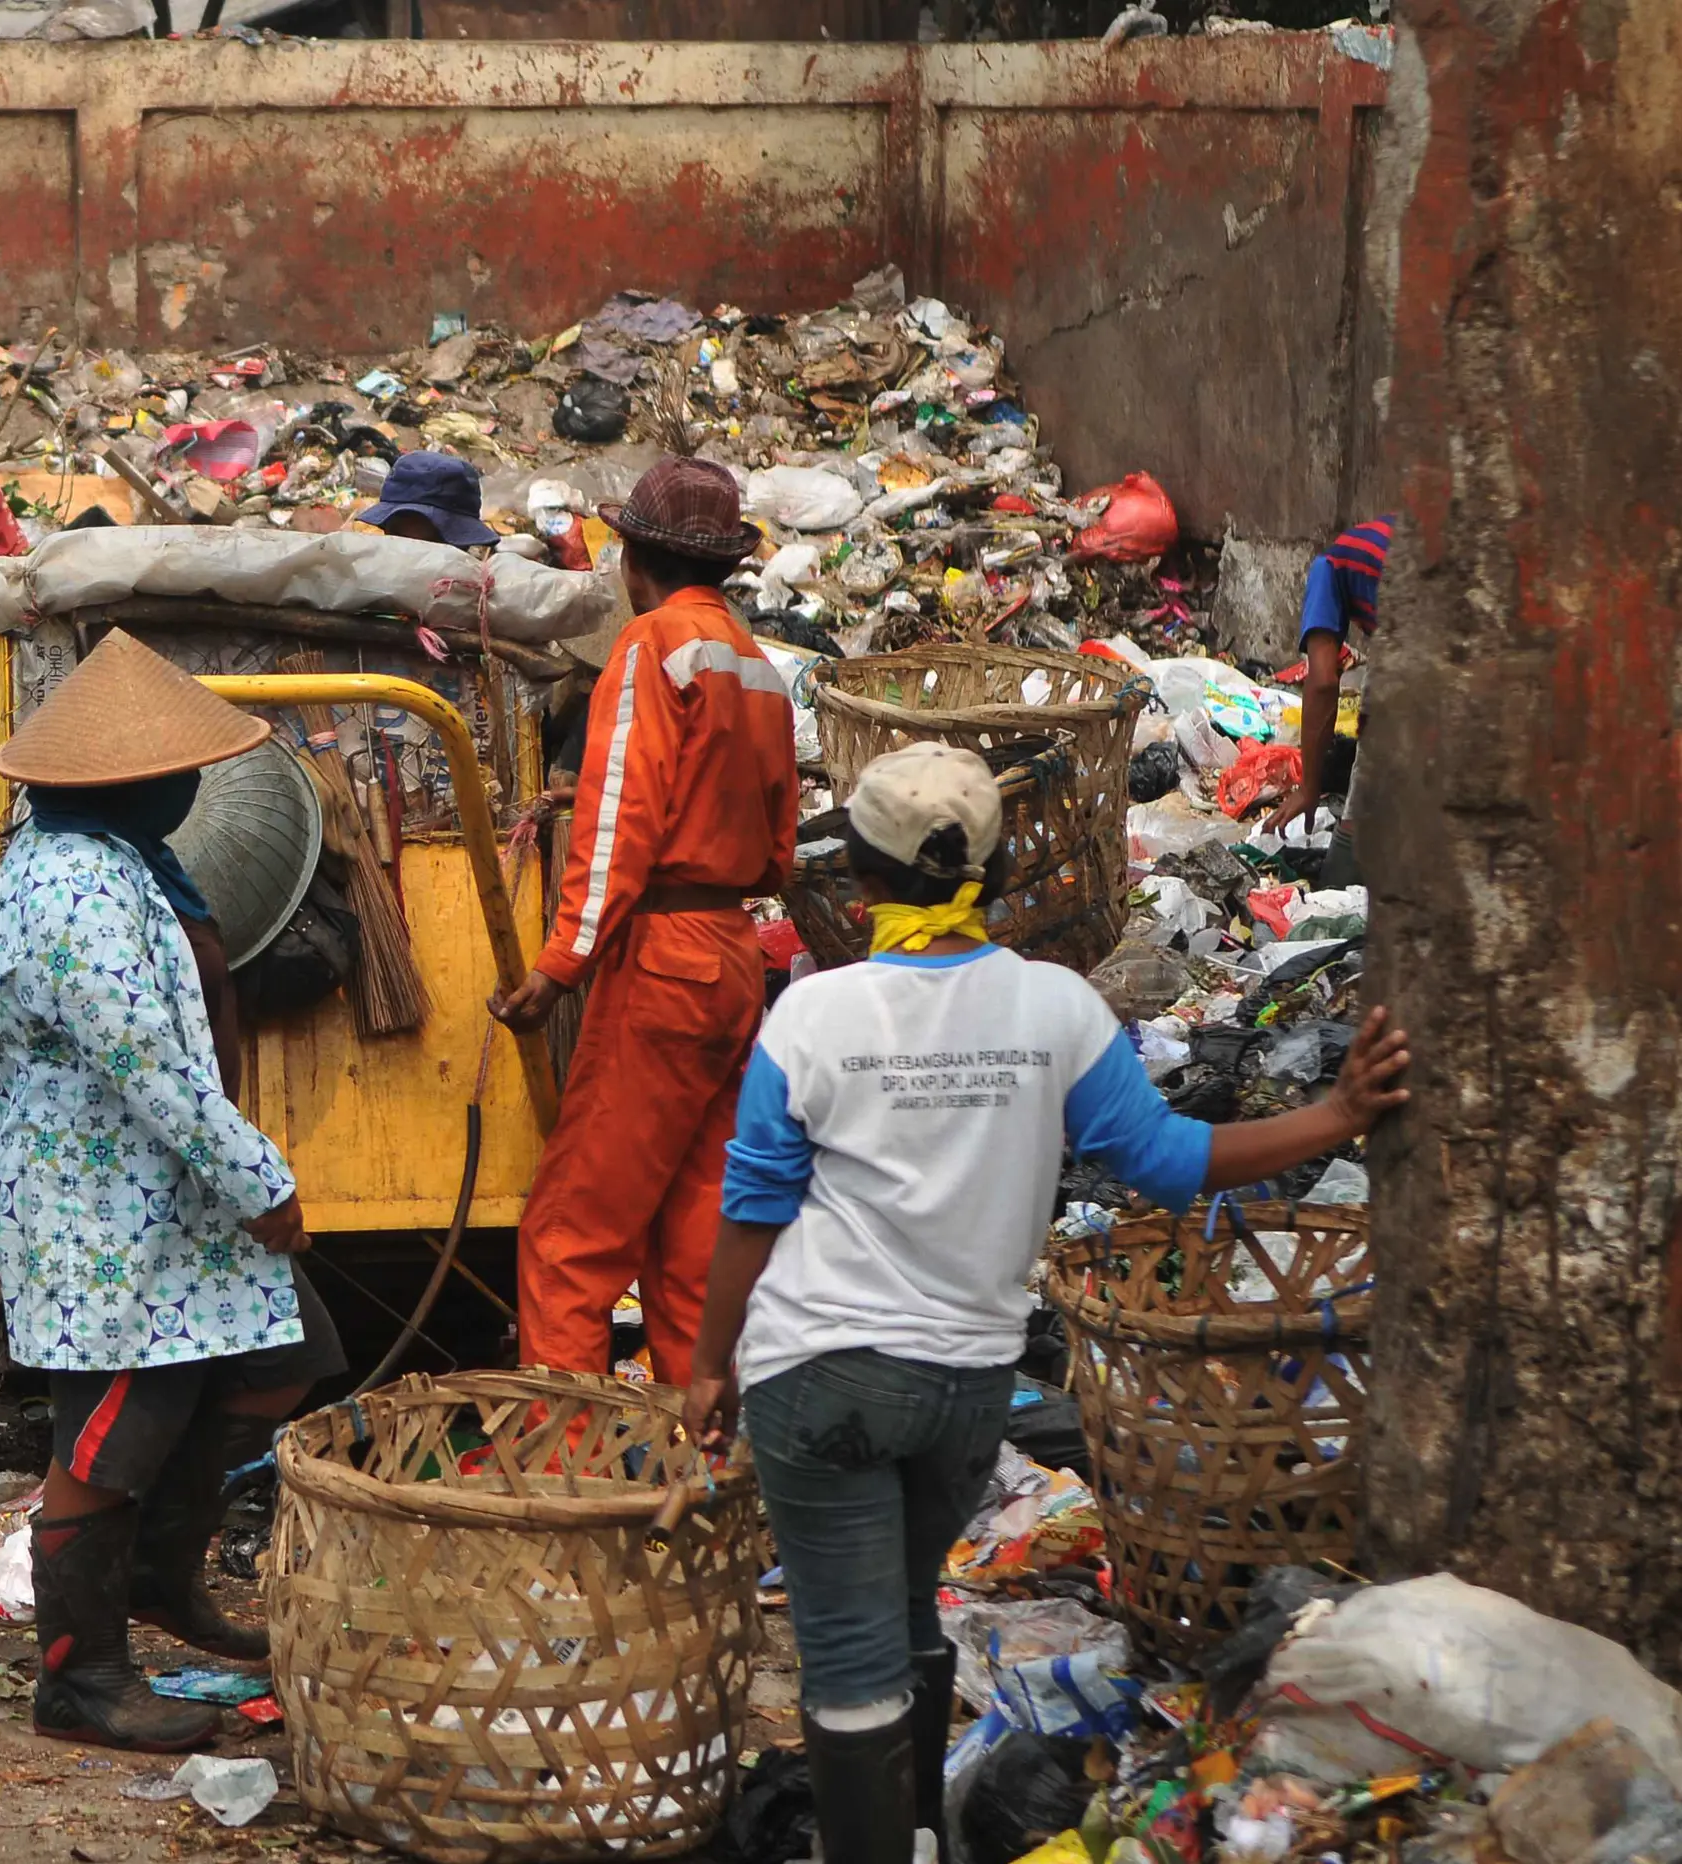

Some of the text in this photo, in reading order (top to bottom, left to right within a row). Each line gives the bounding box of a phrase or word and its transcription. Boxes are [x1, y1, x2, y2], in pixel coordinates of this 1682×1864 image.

[841, 1055, 885, 1072] KEMAH
[889, 1051, 975, 1071] KEBANGSAAN
[978, 1049, 1029, 1067] PEMUDA
[966, 1070, 1020, 1089] JAKARTA
